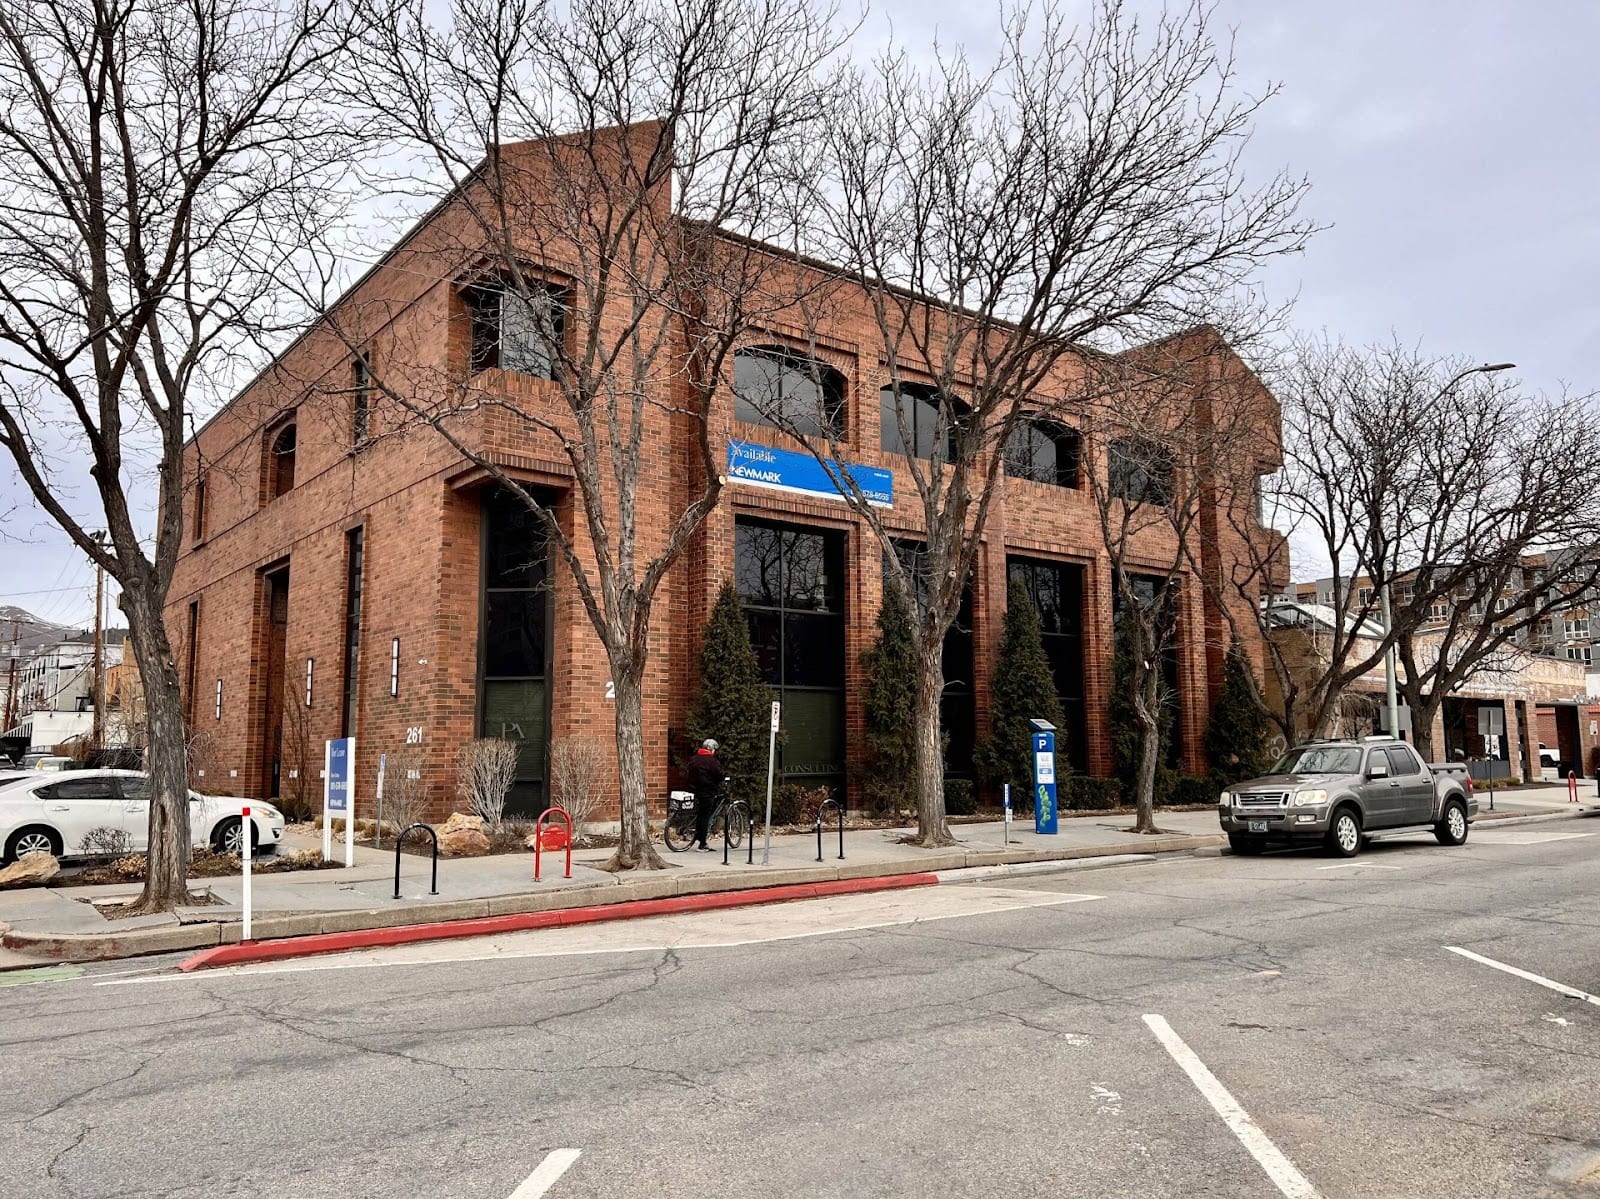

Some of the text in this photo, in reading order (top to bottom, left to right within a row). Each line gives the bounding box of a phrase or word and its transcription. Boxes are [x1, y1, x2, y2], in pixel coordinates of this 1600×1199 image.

[731, 448, 777, 464] Available
[730, 465, 782, 483] NEWMARK
[406, 726, 423, 744] 261
[1038, 739, 1047, 750] P
[784, 762, 842, 773] CONSULTIN
